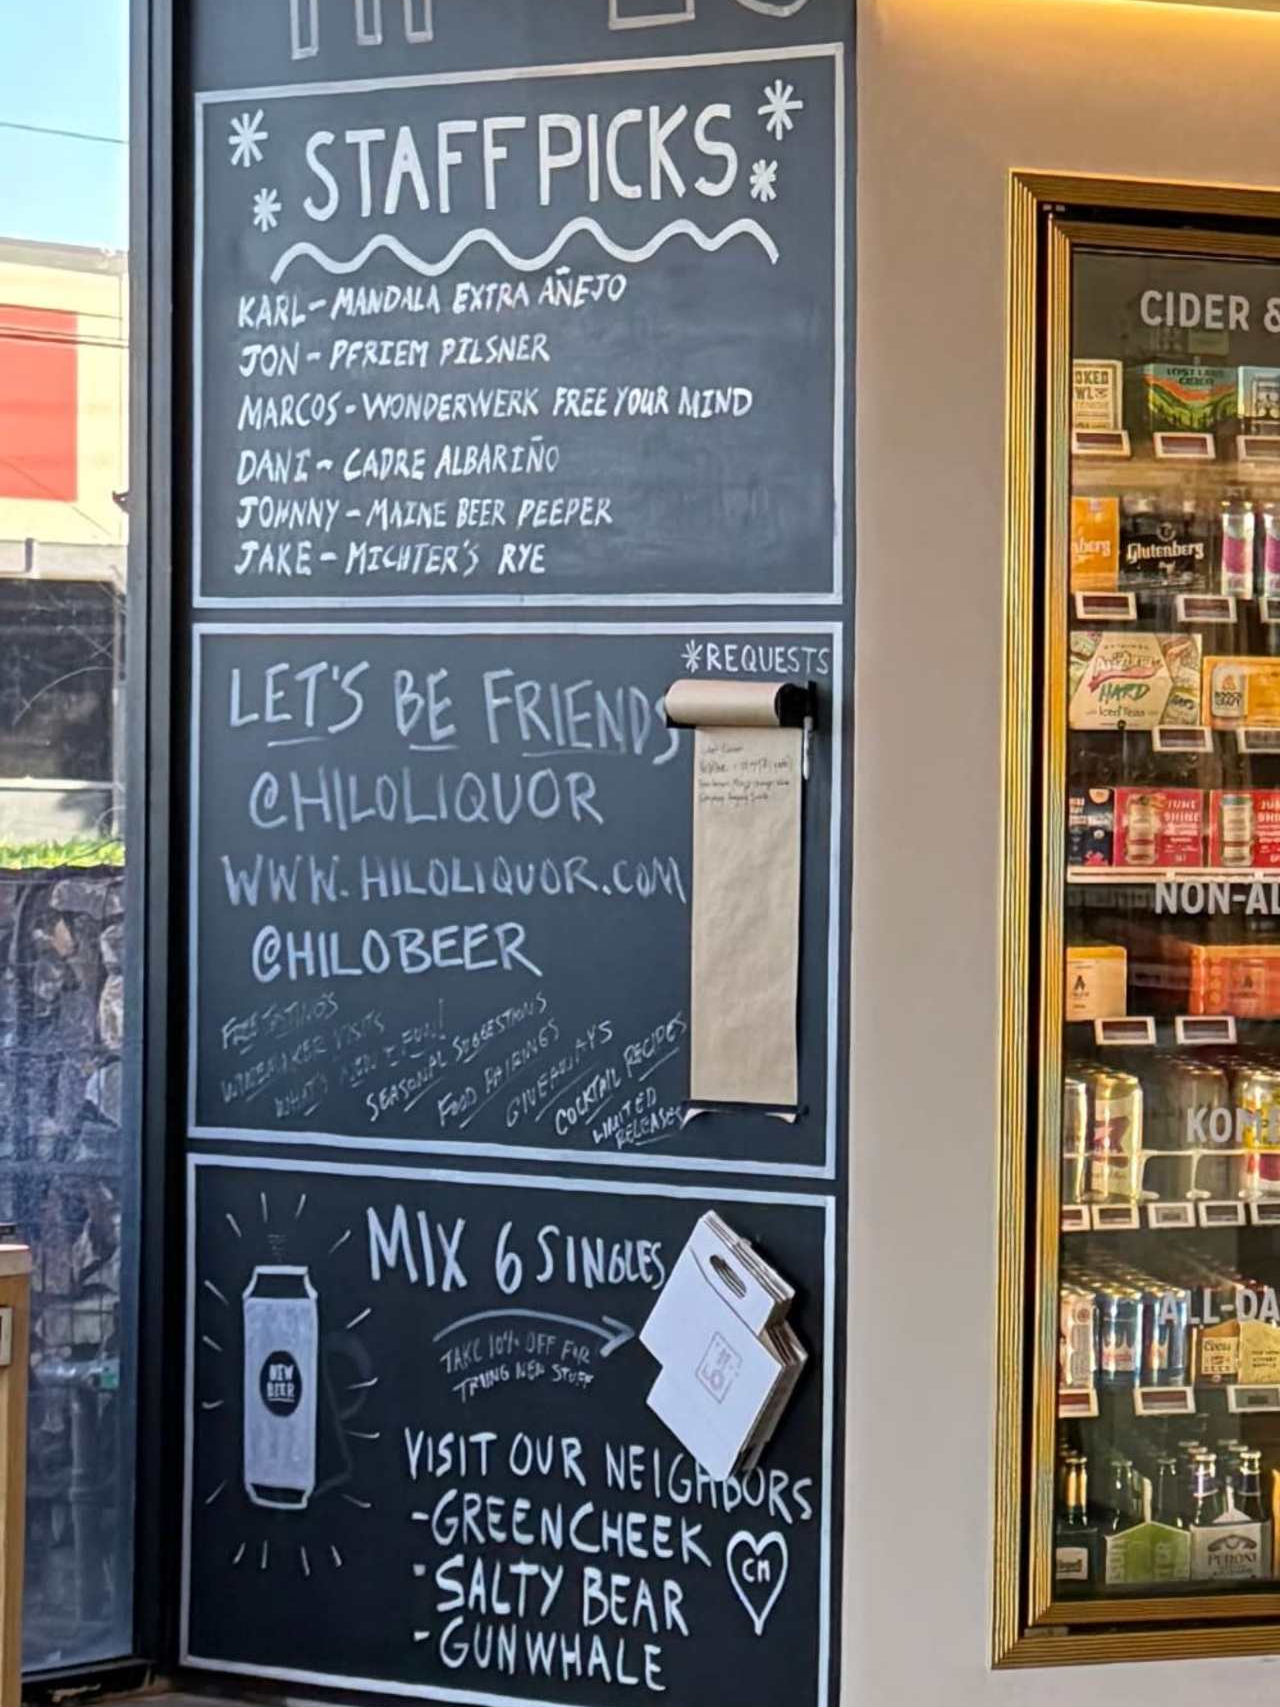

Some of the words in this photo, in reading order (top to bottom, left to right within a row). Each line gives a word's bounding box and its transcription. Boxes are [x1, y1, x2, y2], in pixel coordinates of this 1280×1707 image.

[303, 114, 525, 222] STAFF
[538, 103, 740, 212] PICKS
[330, 284, 441, 321] MANDALA
[452, 281, 530, 315] EXTRA
[538, 265, 627, 309] AÑEJO
[1139, 289, 1250, 333] CIDER
[239, 341, 300, 378] JON
[329, 339, 430, 371] PFRIEM
[440, 333, 551, 367] PILSNER
[552, 386, 609, 419] FREE
[612, 384, 670, 419] YOUR
[677, 385, 754, 419] MIND
[236, 447, 311, 486] DANI
[342, 446, 427, 482] CADRE
[433, 434, 560, 480] ALBARIÑO
[236, 495, 341, 533] JOHNNY
[366, 496, 448, 532] MAINE
[455, 496, 507, 529] BEER
[516, 496, 613, 530] PEEPER
[234, 540, 313, 576] JAKE
[497, 542, 546, 576] RYE
[1126, 540, 1205, 565] Glutenberg
[229, 660, 370, 735] LET'S
[394, 667, 458, 746] BE
[483, 668, 683, 767] FRIENDS
[366, 1203, 468, 1294] MIX
[494, 1220, 525, 1296] 6
[535, 1222, 669, 1292] SINGLES
[405, 1425, 498, 1481] VISIT
[508, 1433, 585, 1488] OUR
[435, 1560, 563, 1618] SALTY
[581, 1564, 690, 1637] BEAR
[438, 1614, 668, 1693] GUNWHALE
